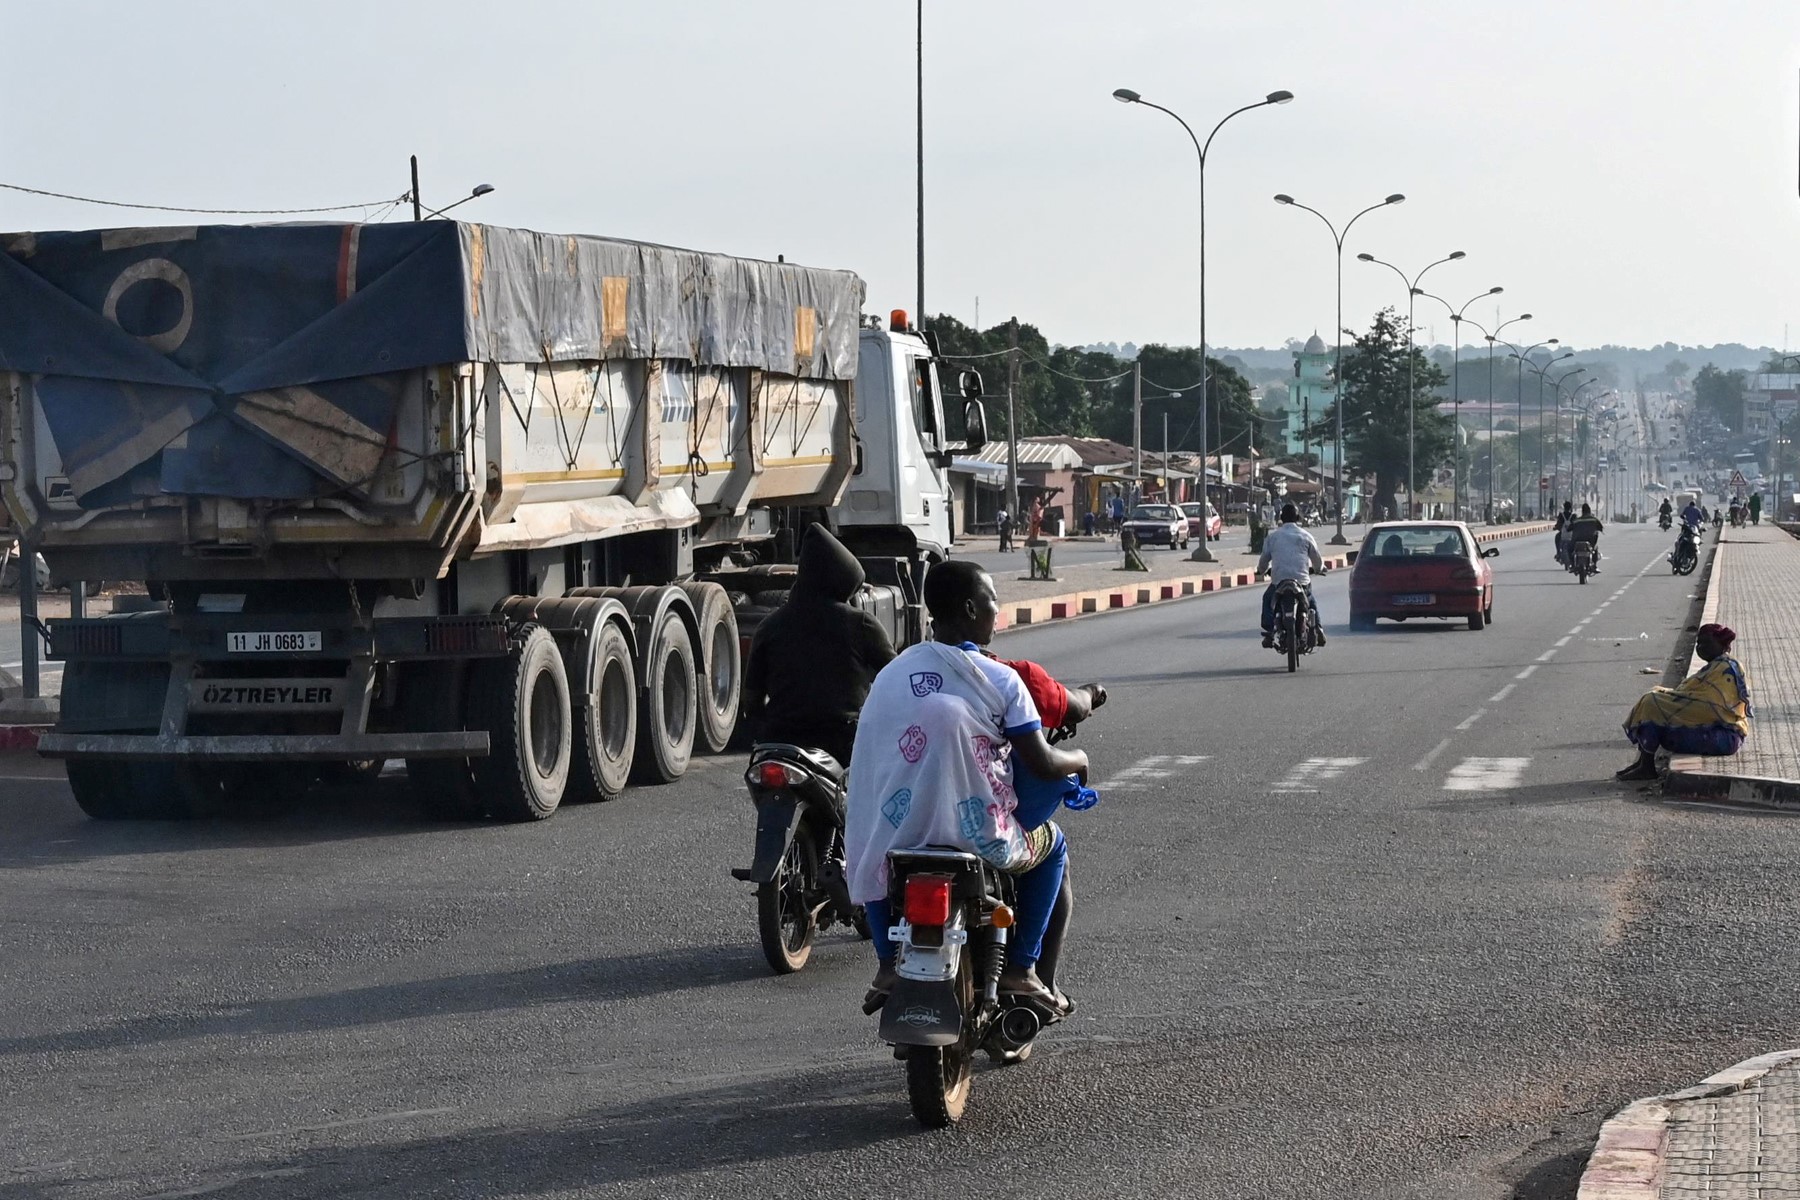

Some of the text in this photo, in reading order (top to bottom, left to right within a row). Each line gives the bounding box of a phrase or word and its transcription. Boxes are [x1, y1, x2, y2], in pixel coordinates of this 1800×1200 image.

[233, 634, 304, 650] 11 JH 0683
[203, 684, 333, 704] ÖZTREYLER
[896, 1014, 941, 1024] APSONIC
